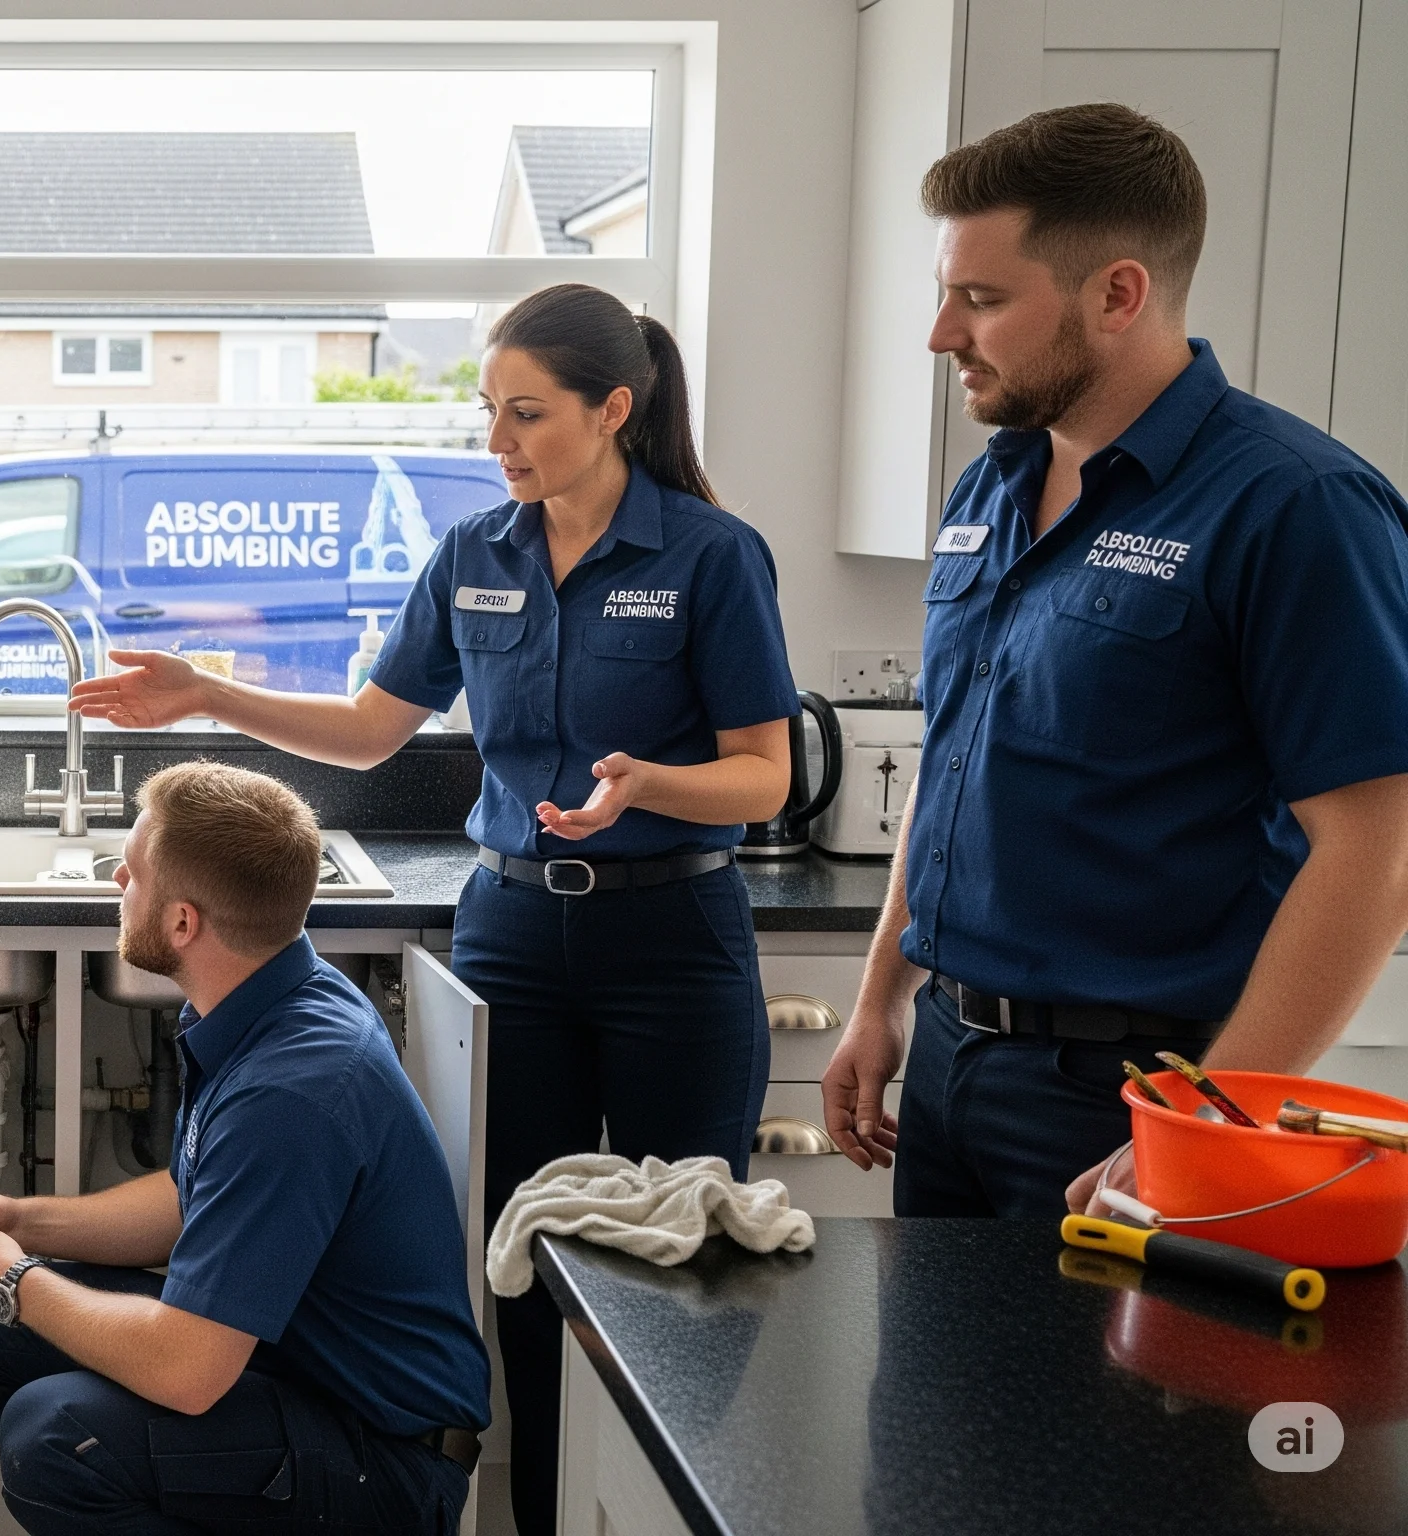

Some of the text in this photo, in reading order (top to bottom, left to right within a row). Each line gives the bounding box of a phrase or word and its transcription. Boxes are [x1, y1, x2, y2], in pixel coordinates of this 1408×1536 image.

[145, 501, 341, 534] ABSOLUTE
[146, 535, 340, 568] PLUMBING
[1093, 529, 1191, 562] ABSOLUTE
[605, 590, 679, 605] ABSOLUTE
